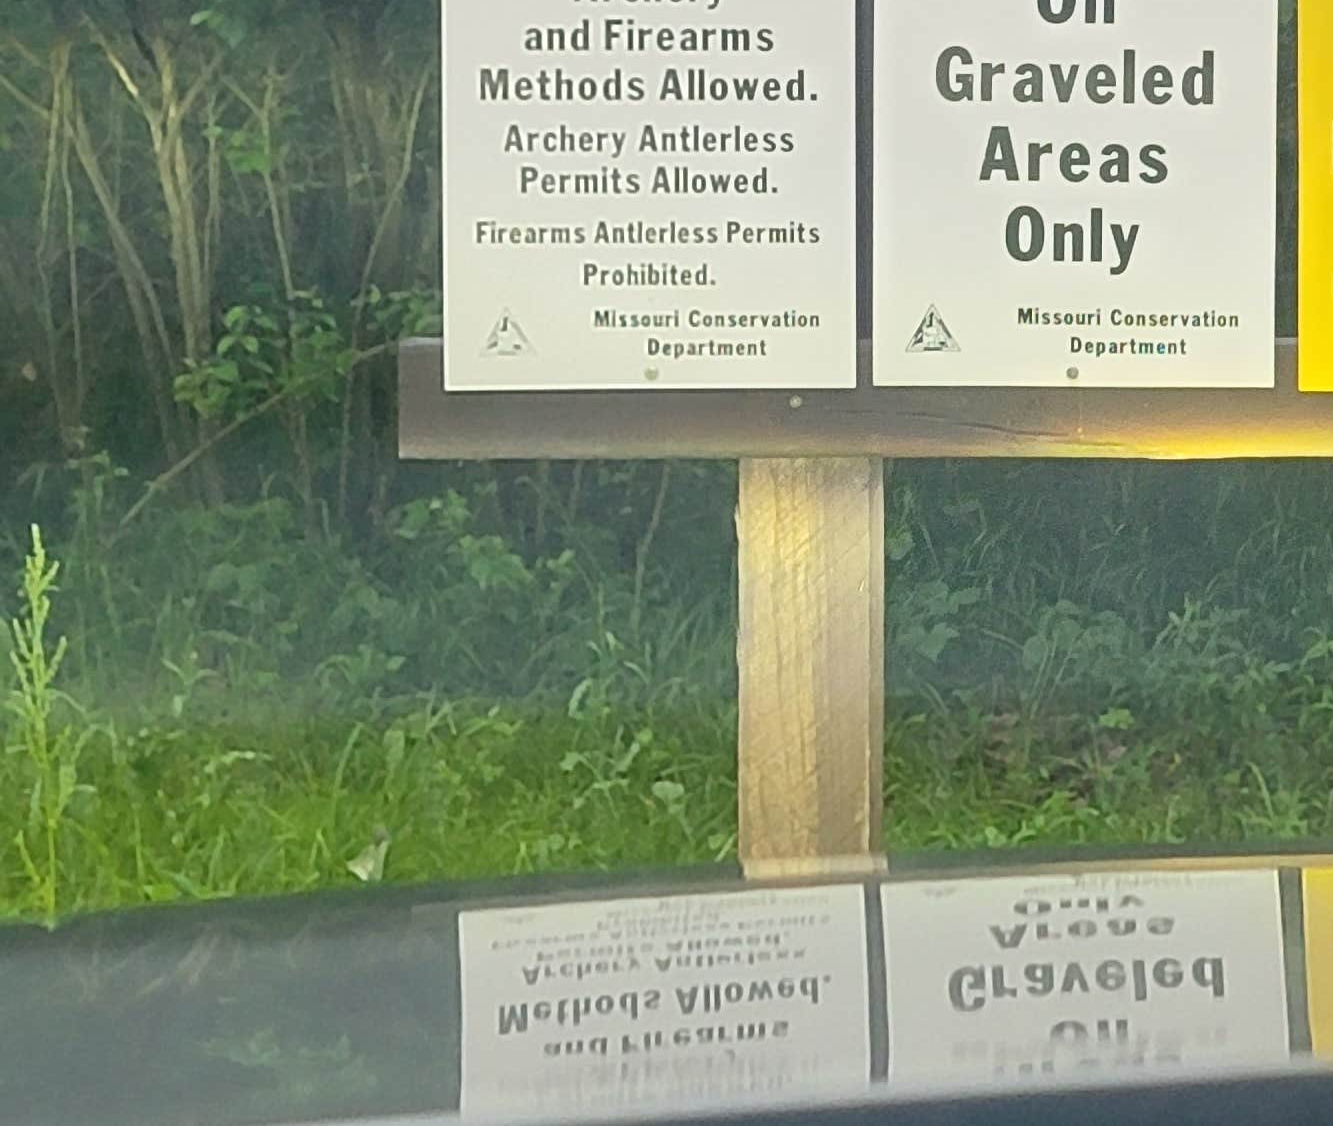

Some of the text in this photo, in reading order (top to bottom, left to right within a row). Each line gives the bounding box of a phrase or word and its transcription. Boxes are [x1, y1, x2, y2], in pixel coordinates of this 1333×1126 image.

[524, 18, 774, 52] and Firearms
[479, 68, 818, 102] Methods Allowed.
[935, 45, 1215, 106] Graveled
[503, 124, 795, 159] Archery Antlerless
[978, 125, 1169, 185] Areas
[520, 165, 778, 195] Permits Allowed.
[476, 220, 820, 245] Firearms Antlerless Permits
[1005, 205, 1140, 276] Only
[583, 262, 716, 286] Prohibited.
[593, 309, 820, 328] Missouri Conservation
[1017, 307, 1239, 328] Missouri Conservation
[647, 337, 767, 360] Department
[1070, 336, 1187, 358] Department
